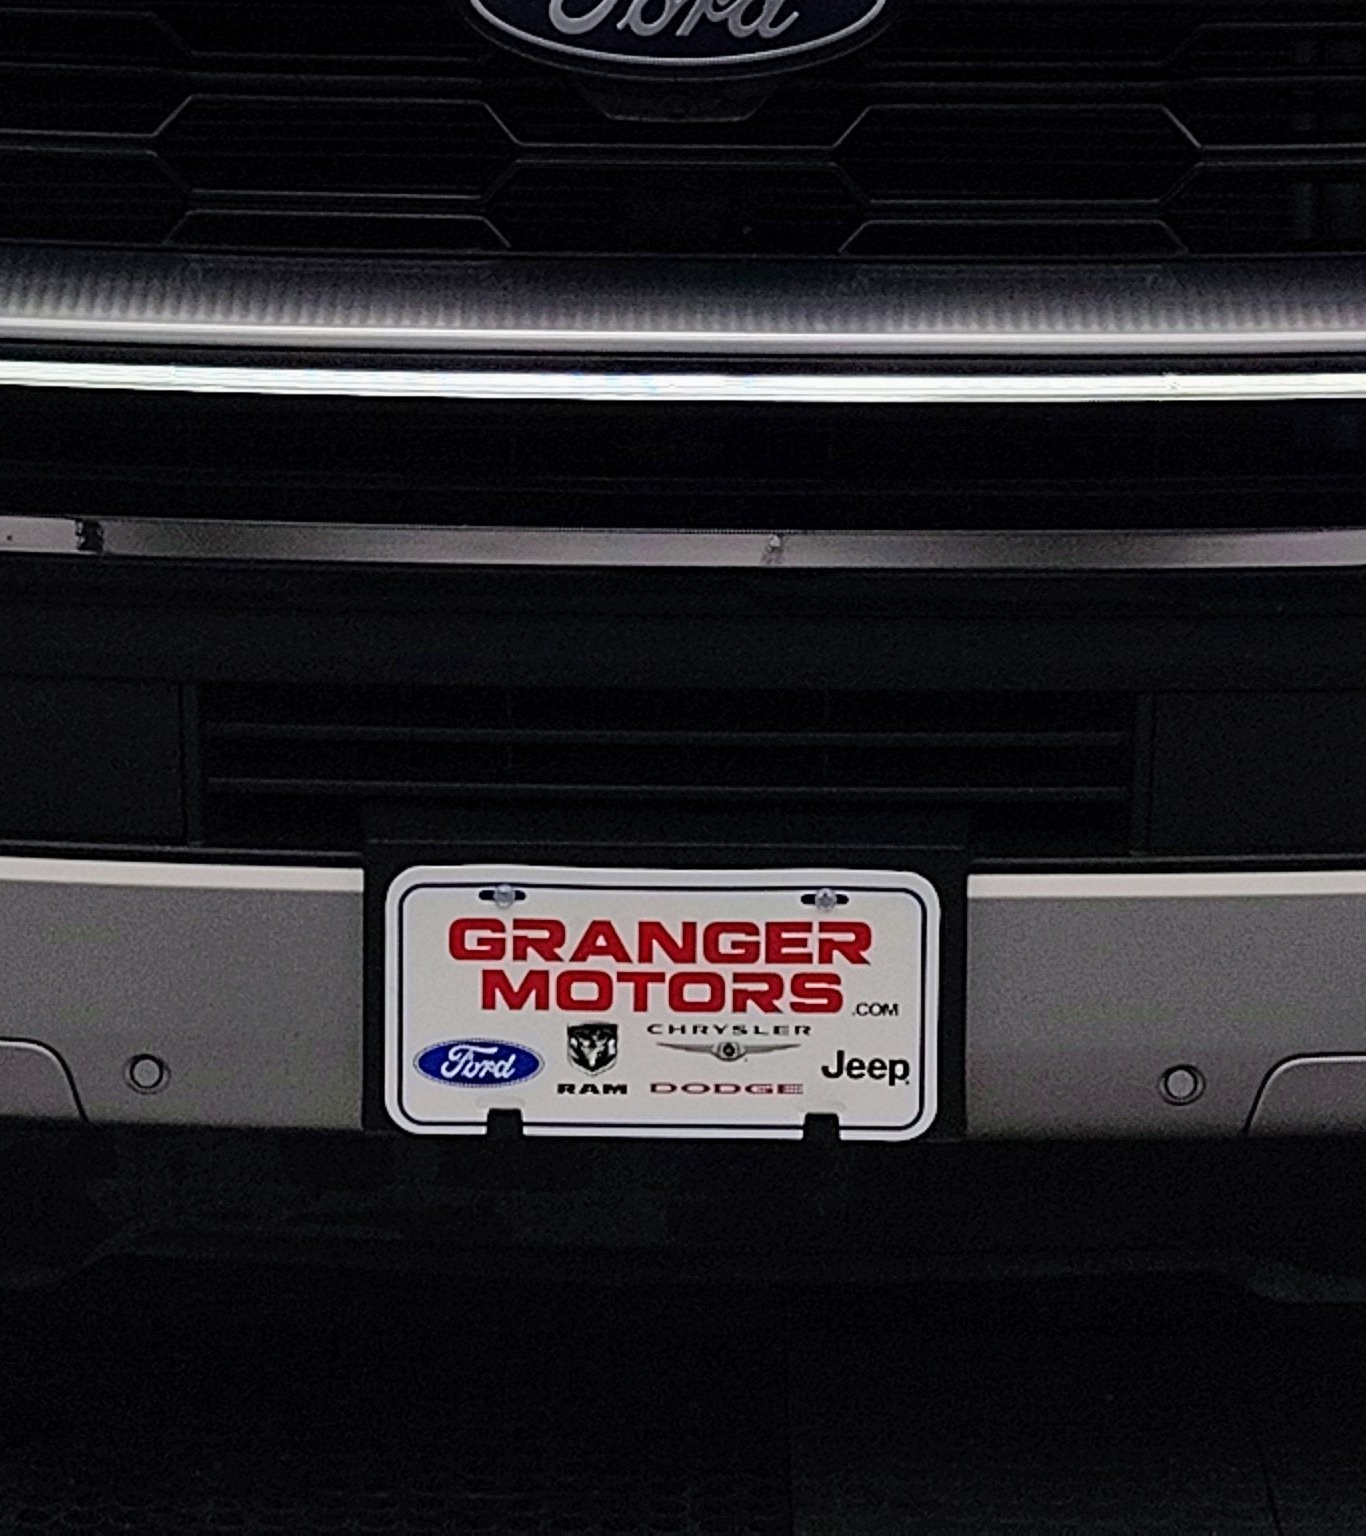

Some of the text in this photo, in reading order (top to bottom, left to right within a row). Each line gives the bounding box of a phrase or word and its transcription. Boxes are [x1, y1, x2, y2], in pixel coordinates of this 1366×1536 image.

[448, 917, 872, 965] GRANGER
[481, 969, 900, 1017] MOTORS .COM
[646, 1023, 812, 1036] CHRYSLER
[440, 1039, 516, 1080] Ford
[821, 1050, 910, 1085] Jeep
[557, 1083, 628, 1096] RAM
[650, 1082, 804, 1096] DODGE
